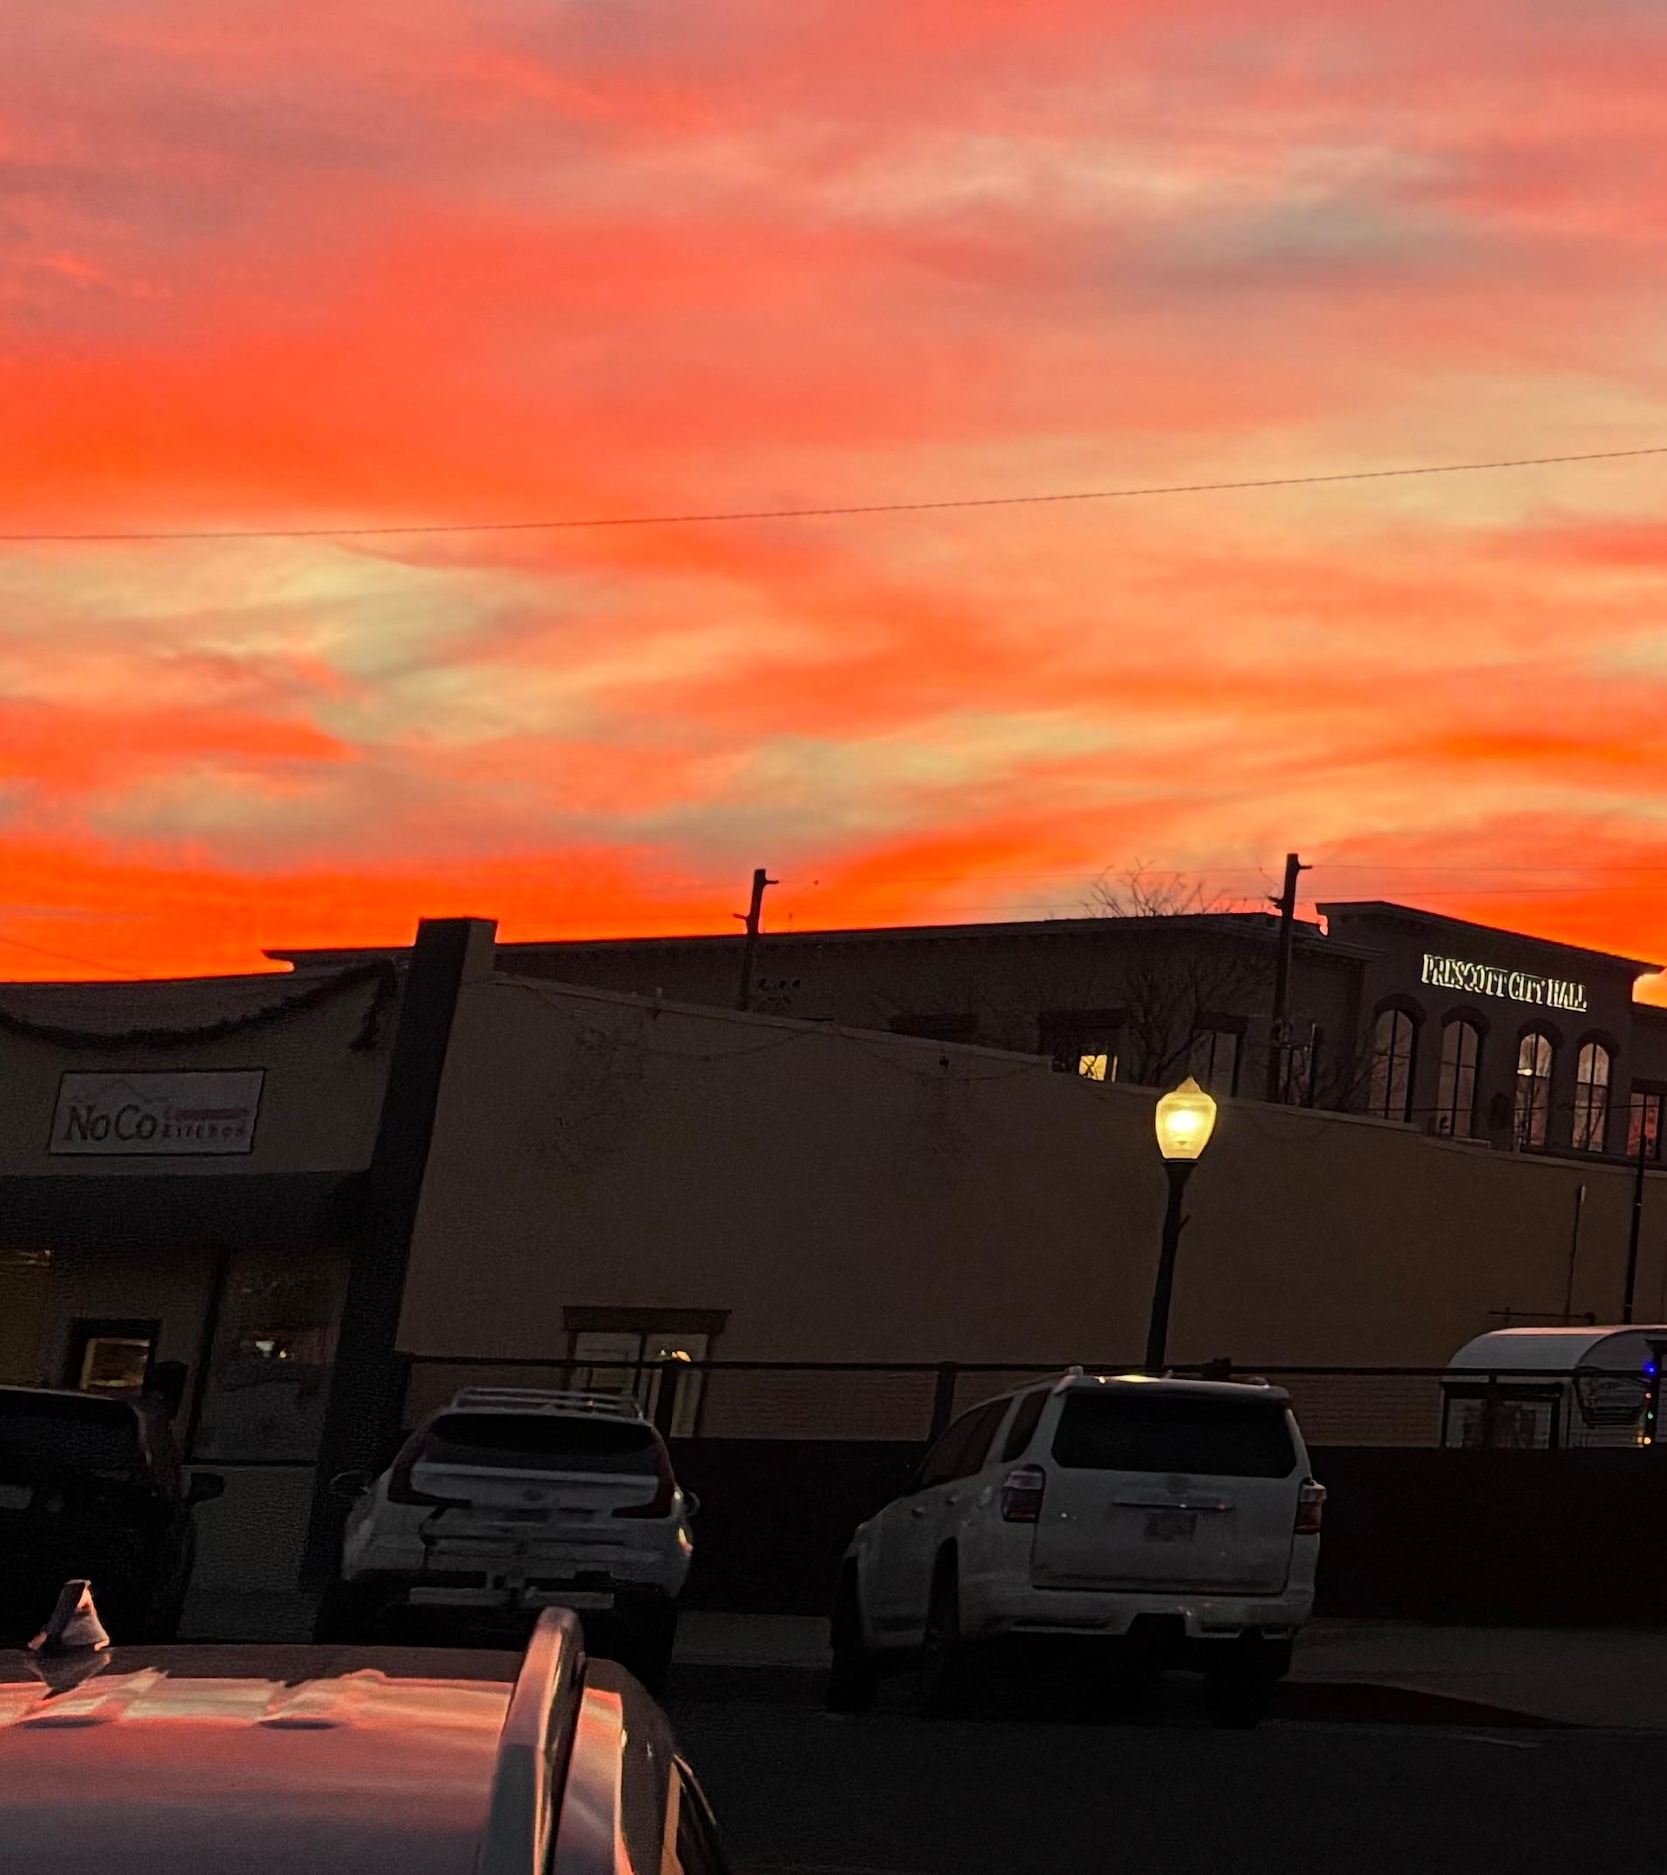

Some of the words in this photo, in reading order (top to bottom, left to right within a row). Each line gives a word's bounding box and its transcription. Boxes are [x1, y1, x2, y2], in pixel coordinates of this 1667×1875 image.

[1421, 953, 1508, 998] PRESCOTT
[1508, 971, 1546, 1005] CITY
[1546, 978, 1588, 1013] HALL
